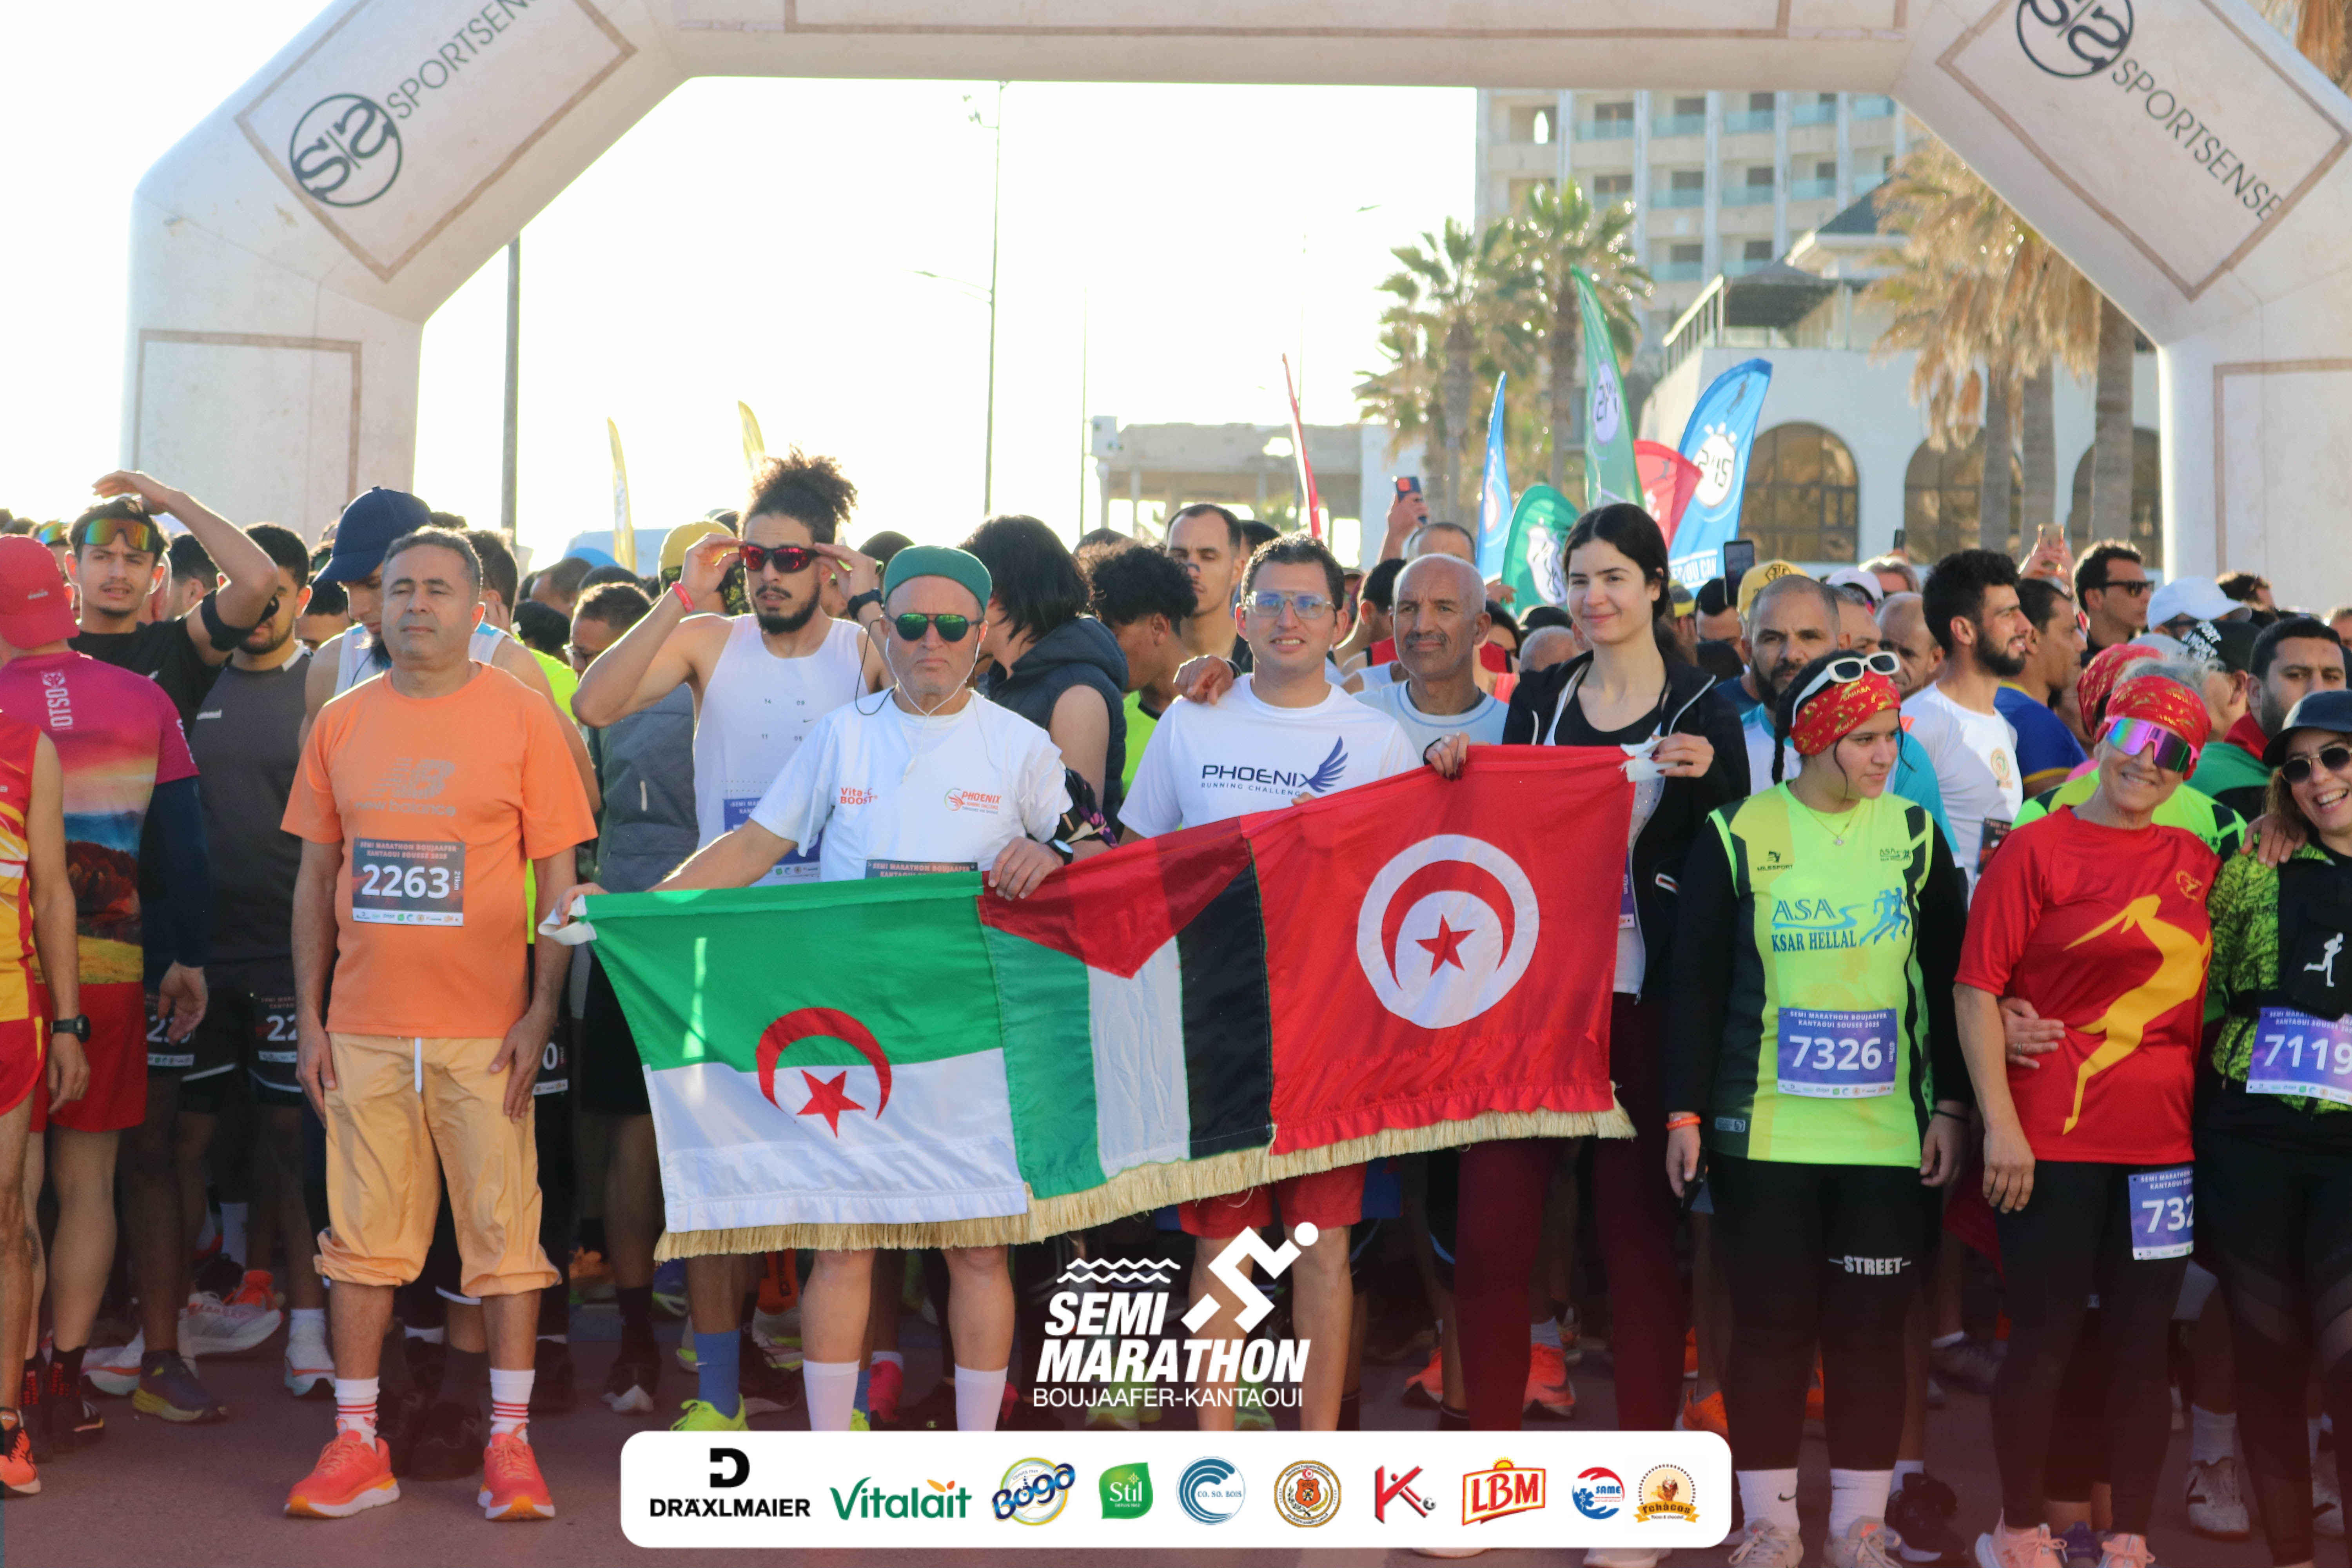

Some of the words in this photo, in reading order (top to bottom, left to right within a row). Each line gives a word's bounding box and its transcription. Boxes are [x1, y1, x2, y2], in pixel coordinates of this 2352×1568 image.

[387, 0, 539, 120] SPORTSEN
[2112, 59, 2284, 221] SPORTSENSE
[1700, 557, 1717, 577] CAN
[45, 687, 73, 727] OTSO
[1202, 765, 1309, 788] PHOENIX
[962, 790, 1002, 804] PHOENIX
[1248, 785, 1300, 797] CHALLENG
[354, 801, 387, 811] new
[388, 799, 456, 817] balance
[376, 842, 414, 851] MARATHON
[416, 844, 457, 852] BOUJAAFER
[890, 863, 930, 871] MARATHON
[361, 864, 450, 899] 2263
[1771, 898, 1837, 922] ASA
[1771, 933, 1806, 953] KSAR
[1809, 930, 1857, 951] HELLAL
[1798, 1020, 1835, 1028] KANTAOUI
[1809, 1012, 1849, 1021] MARATHON
[1851, 1012, 1887, 1021] BOUJAAFER
[2276, 1018, 2310, 1026] KANTAOUI
[1789, 1034, 1883, 1071] 7326
[2264, 1033, 2352, 1075] 7119
[2150, 1180, 2182, 1190] KANTAOUI
